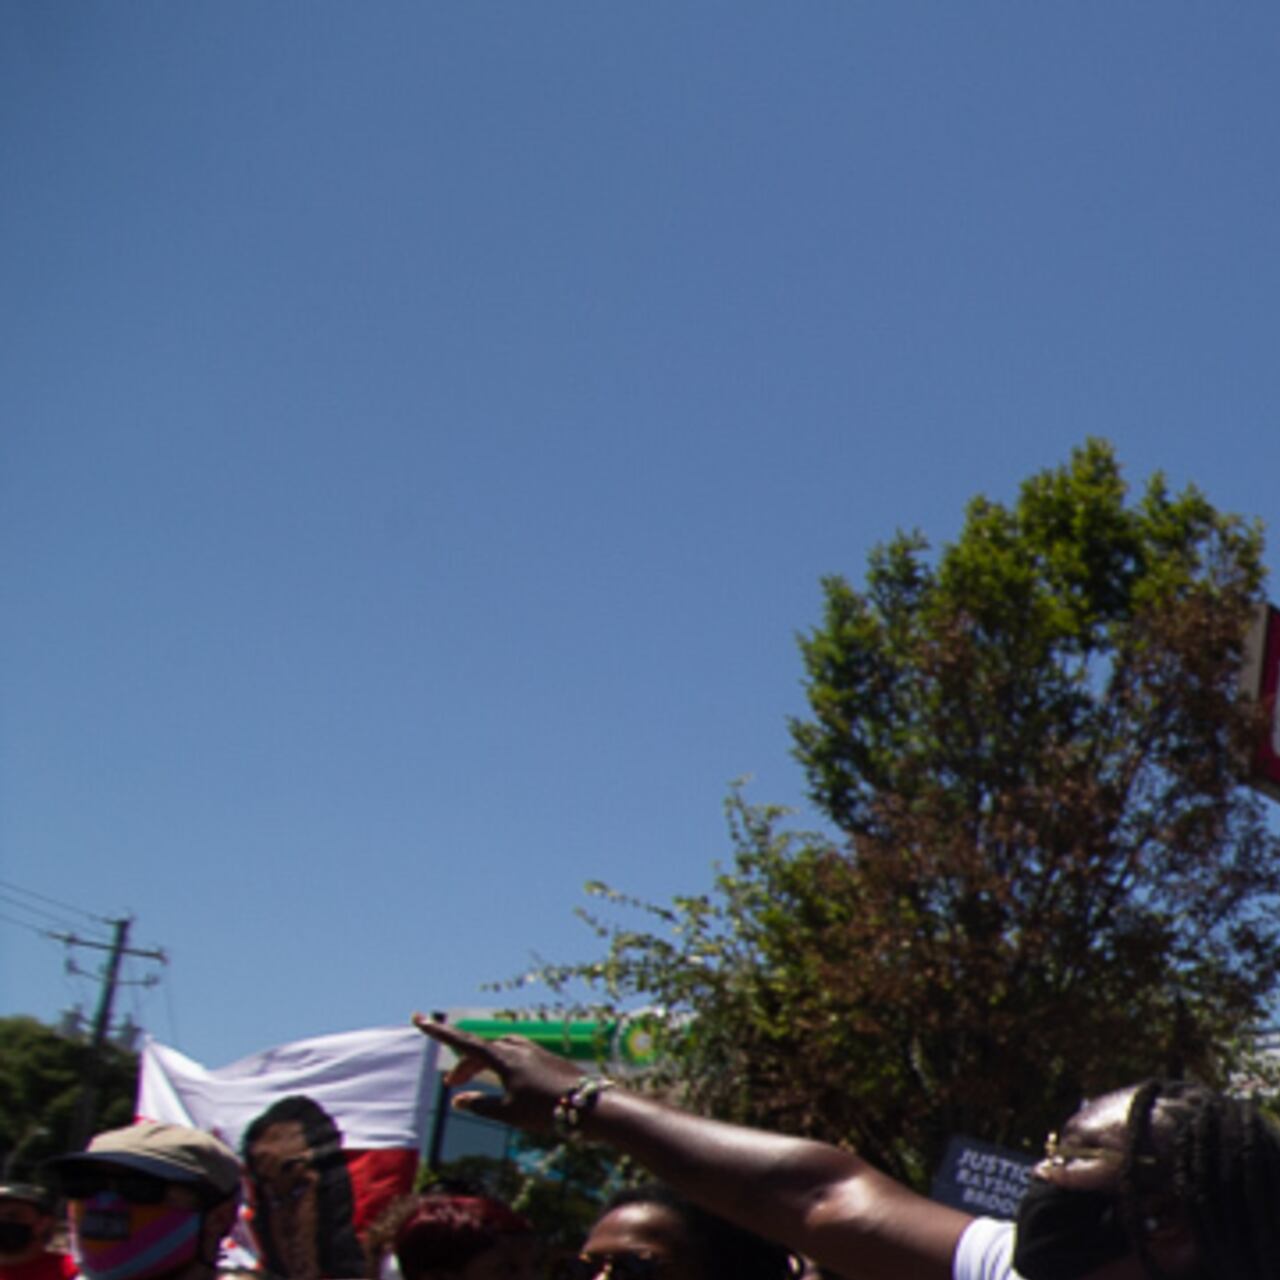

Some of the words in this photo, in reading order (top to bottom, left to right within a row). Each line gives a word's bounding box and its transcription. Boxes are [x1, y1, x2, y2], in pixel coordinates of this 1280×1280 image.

[957, 1148, 1033, 1184] JUSTIC
[956, 1168, 1029, 1200] RAYSHA
[962, 1186, 1018, 1216] BROO
